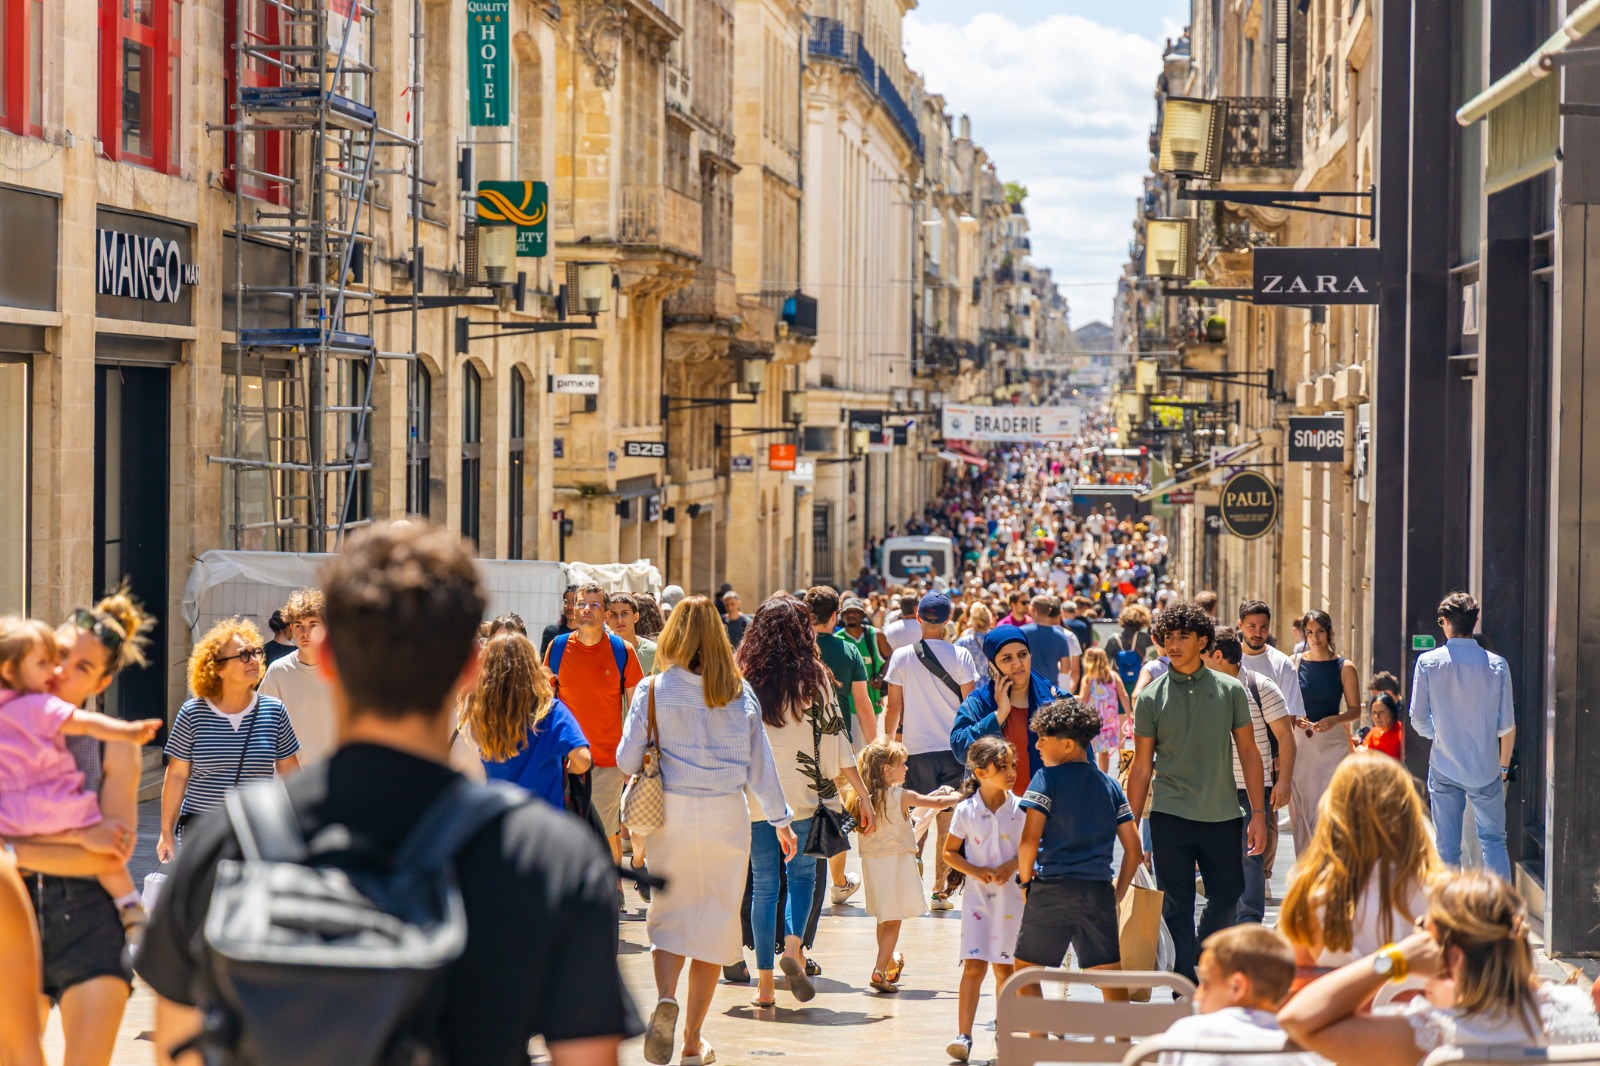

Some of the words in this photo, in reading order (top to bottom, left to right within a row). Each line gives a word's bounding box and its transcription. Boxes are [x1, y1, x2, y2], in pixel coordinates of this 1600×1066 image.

[468, 1, 508, 13] QUALITY
[481, 24, 497, 119] HOTEL
[99, 228, 181, 304] MANGO
[1262, 275, 1369, 293] ZARA
[556, 379, 595, 389] pimkie
[974, 415, 1042, 433] BRADERIE
[627, 442, 665, 456] BZB
[1294, 429, 1344, 451] snipes
[1226, 492, 1272, 507] PAUL
